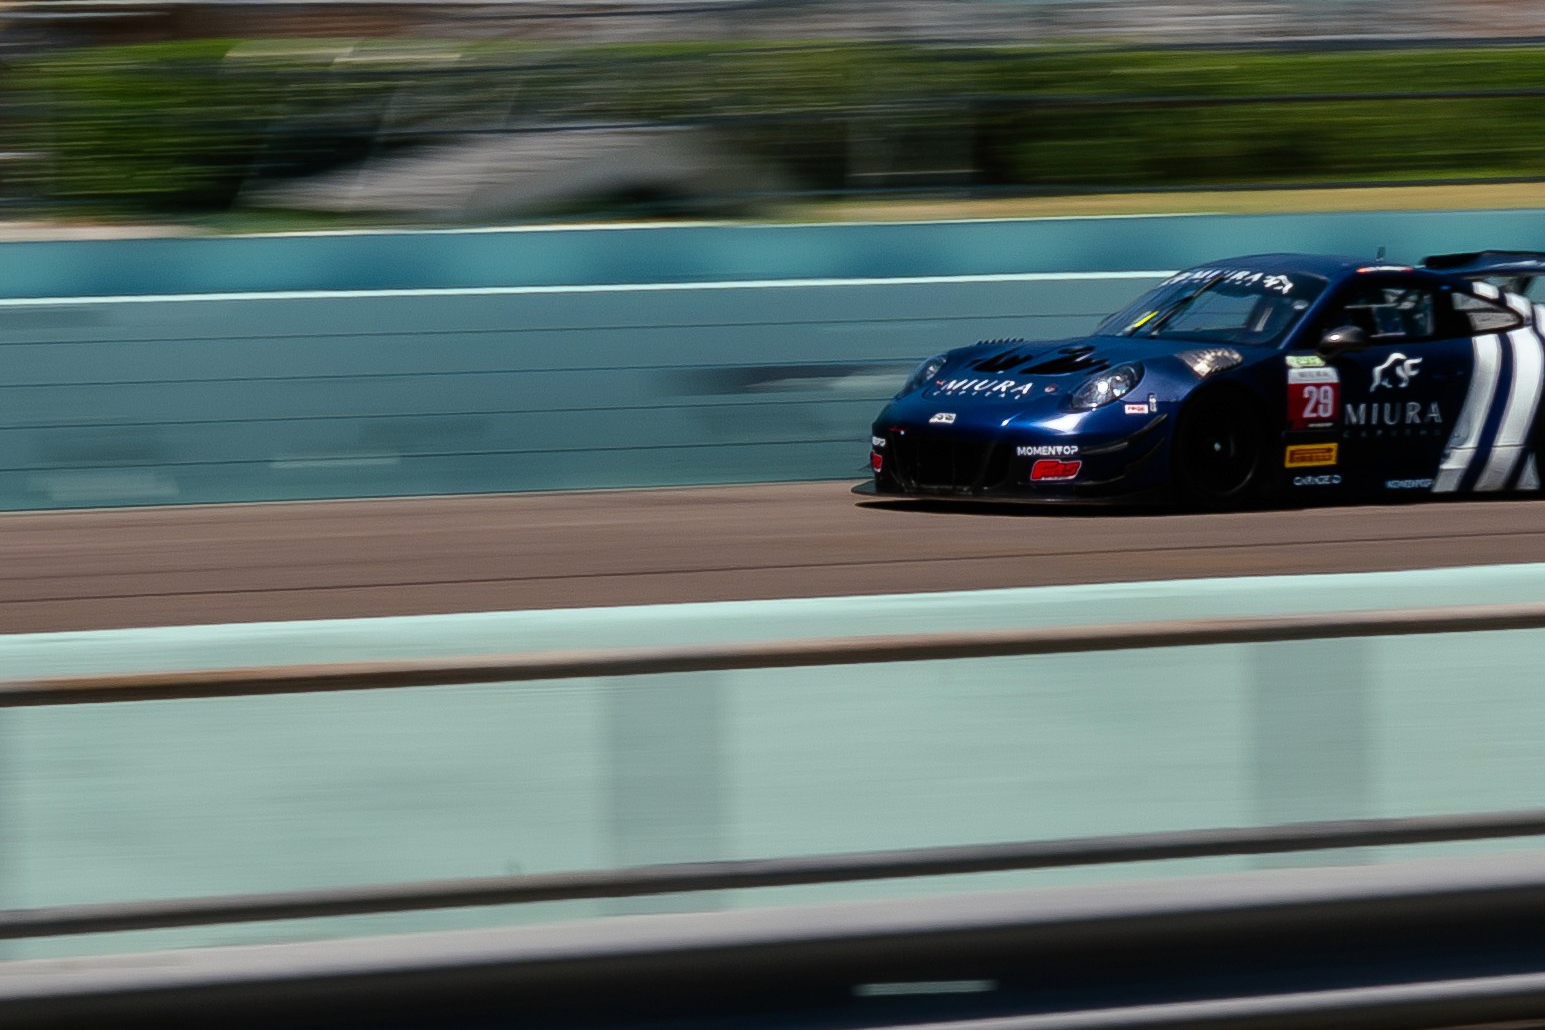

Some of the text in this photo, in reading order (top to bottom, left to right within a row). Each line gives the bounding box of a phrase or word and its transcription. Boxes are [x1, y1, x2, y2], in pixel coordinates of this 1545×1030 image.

[941, 378, 1033, 394] MIURA
[1302, 385, 1335, 418] 29
[1344, 402, 1442, 425] MIURA
